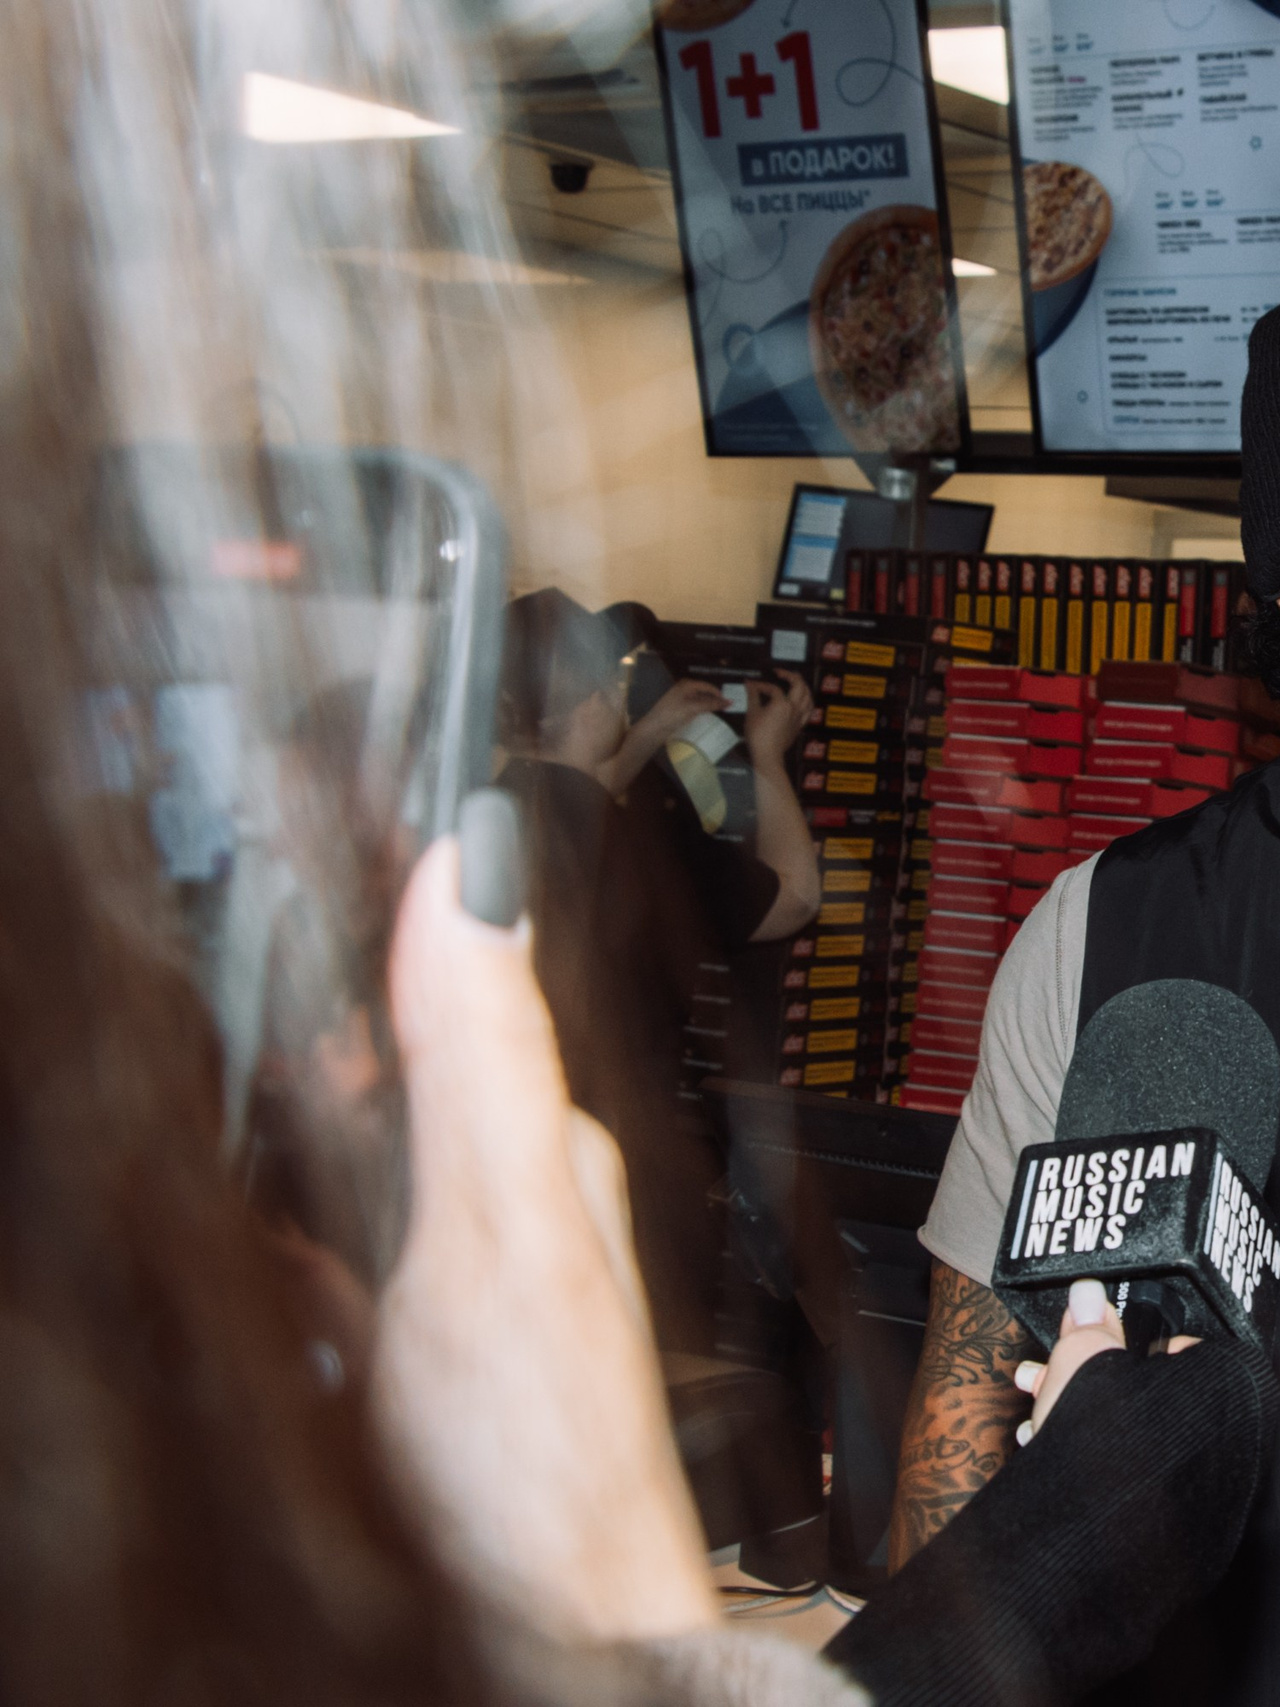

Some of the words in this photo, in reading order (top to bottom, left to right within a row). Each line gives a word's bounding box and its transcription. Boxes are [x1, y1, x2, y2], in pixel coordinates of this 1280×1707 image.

[678, 29, 820, 138] 1+1
[769, 143, 897, 178] ПОДАРОК!
[758, 191, 794, 214] ВСЕ
[1038, 1141, 1196, 1192] RUSSIAN
[1031, 1179, 1146, 1225] MUSIC
[1024, 1213, 1127, 1259] NEWS
[1214, 1193, 1264, 1288] MUSIC
[1209, 1226, 1256, 1314] NEWS
